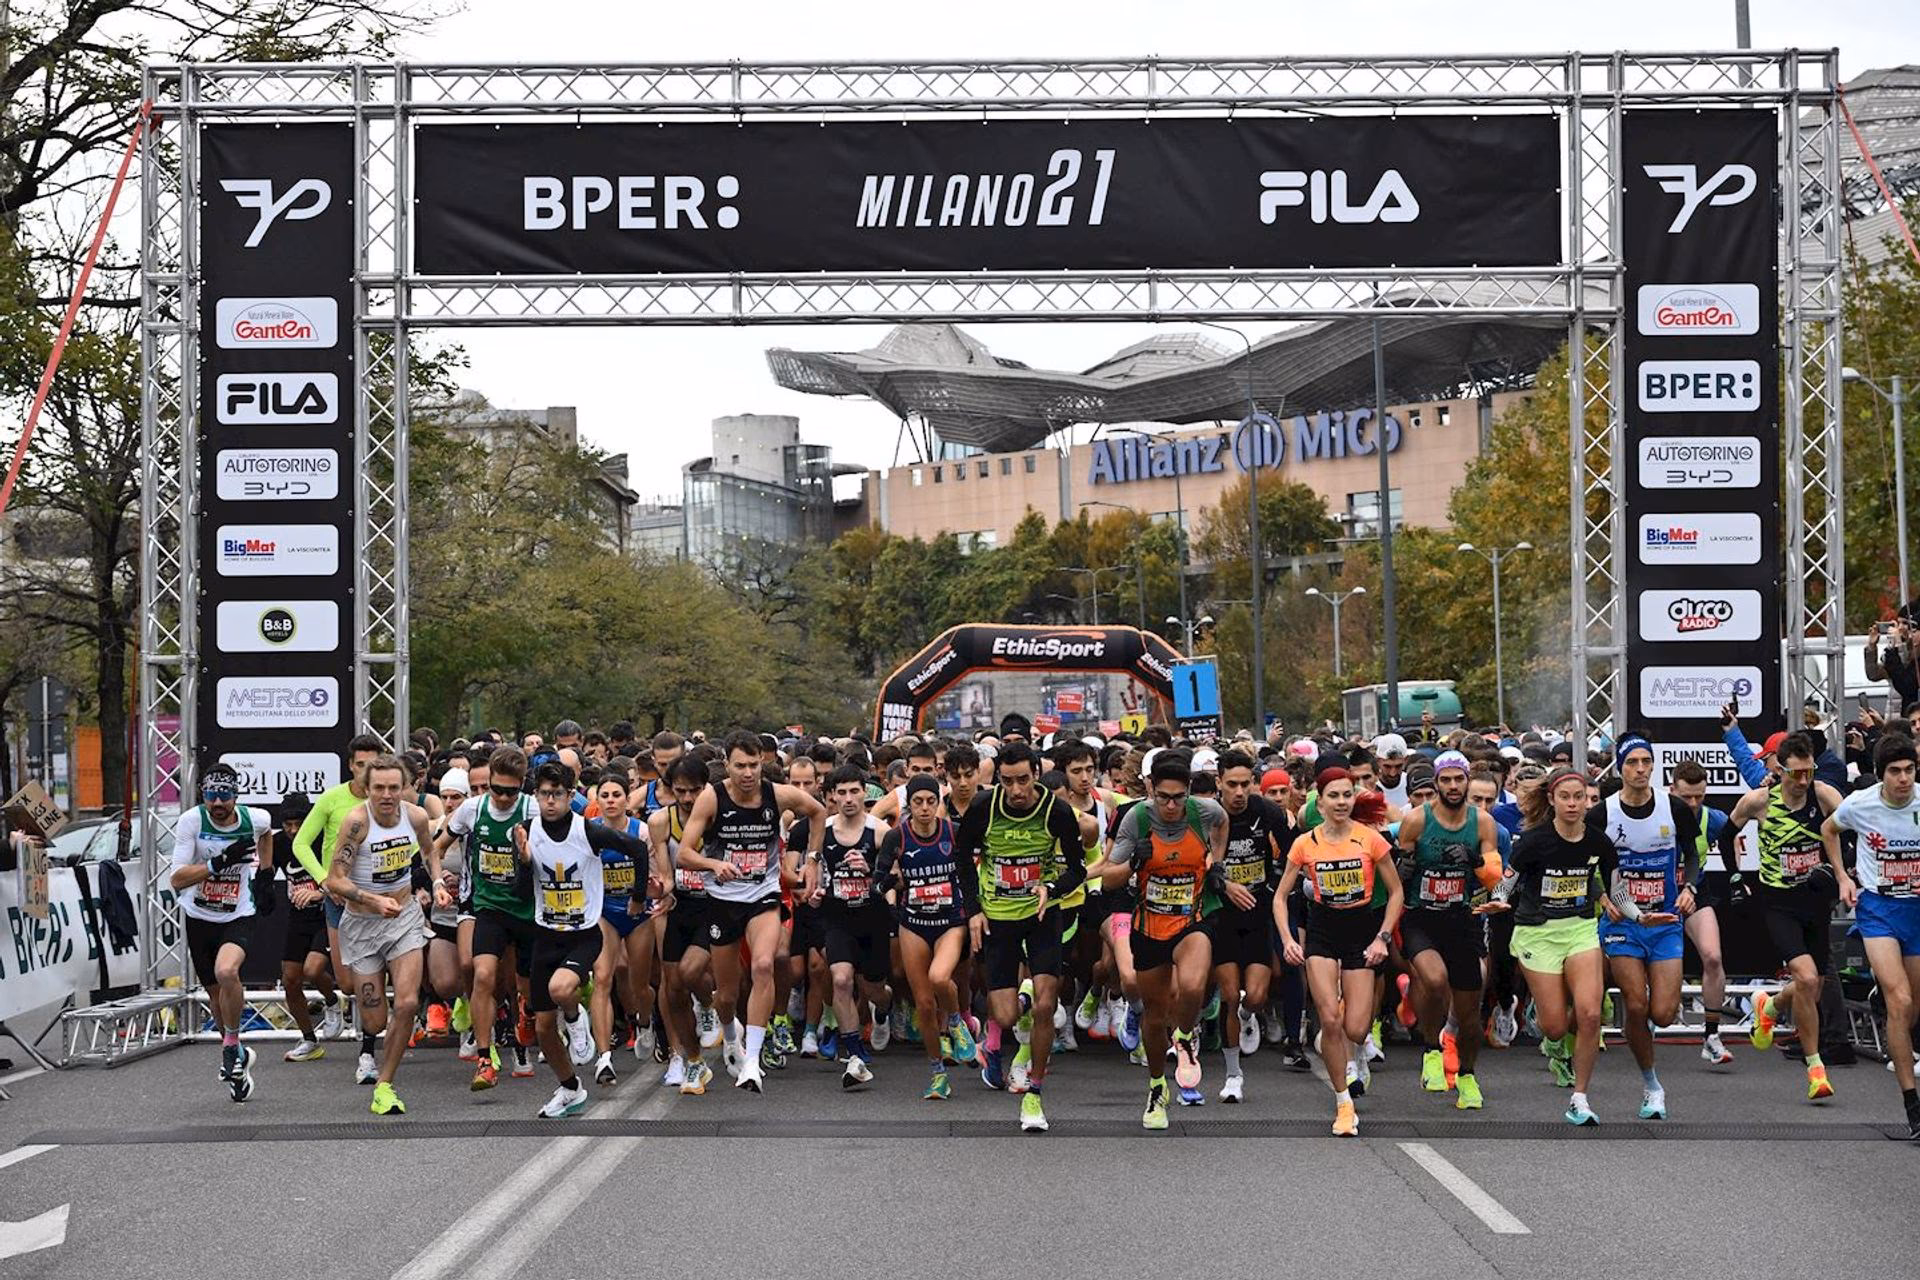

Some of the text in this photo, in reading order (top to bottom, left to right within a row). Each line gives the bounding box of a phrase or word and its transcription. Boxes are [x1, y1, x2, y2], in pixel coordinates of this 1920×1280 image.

[524, 176, 740, 230] BPER:
[1260, 170, 1419, 224] FILA
[1646, 372, 1753, 400] BPER:
[227, 382, 328, 415] FILA
[1089, 407, 1401, 485] Allianz MiCo
[1646, 446, 1754, 461] AUTOTORINO
[224, 458, 331, 473] AUTOTORINO
[1666, 470, 1733, 483] BYD
[244, 482, 310, 495] BYD
[1646, 528, 1698, 544] BigMat
[224, 540, 276, 556] BigMat
[1668, 598, 1733, 622] disco
[264, 619, 292, 631] B&B
[1682, 618, 1716, 628] RADIO
[992, 637, 1105, 659] EthicSport
[907, 650, 958, 692] EthicSport
[1188, 670, 1200, 712] 1
[883, 703, 914, 719] MAKE
[238, 770, 325, 794] 24 ORE
[40, 809, 61, 831] LINE
[1004, 830, 1031, 840] FILA
[387, 850, 405, 866] 8710
[606, 870, 632, 882] BELLO
[1013, 868, 1028, 882] 10
[1329, 872, 1359, 887] LUKAN
[1631, 880, 1664, 896] VENDER
[557, 893, 572, 906] MEI
